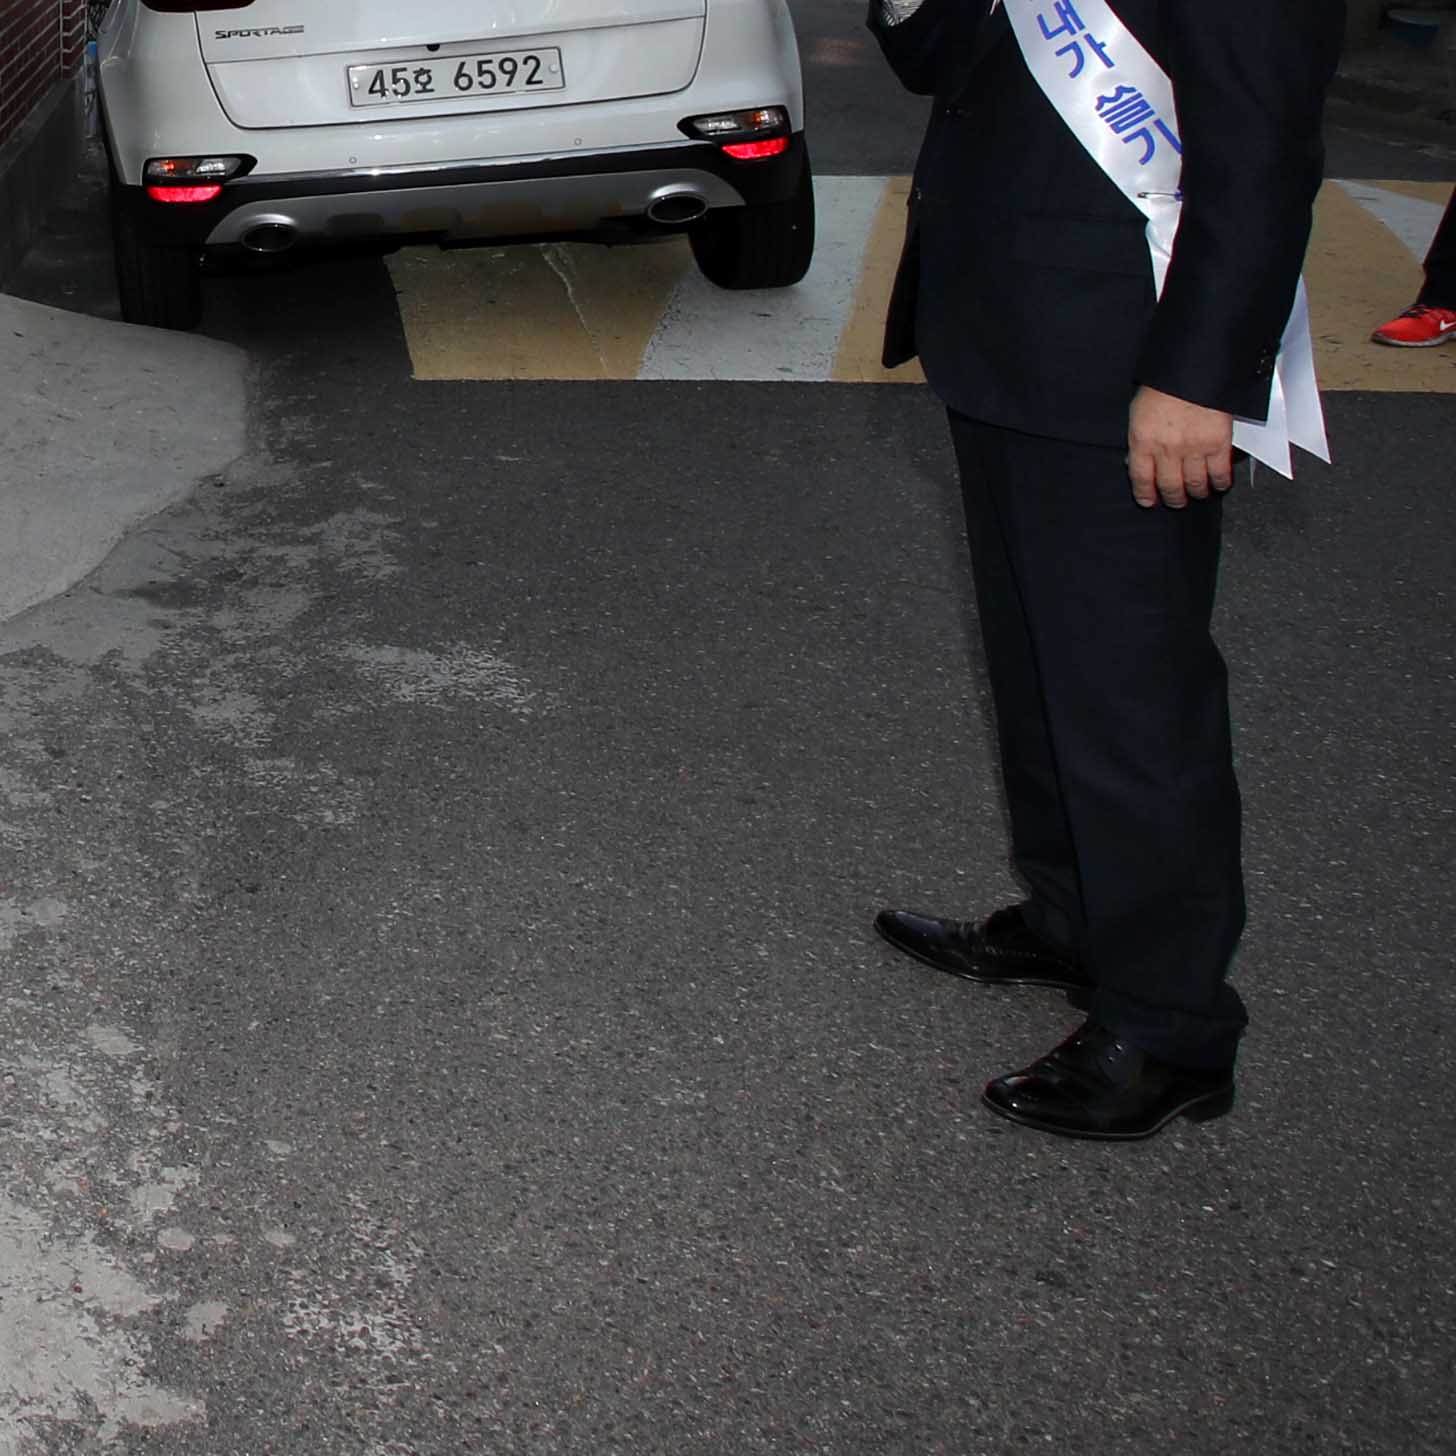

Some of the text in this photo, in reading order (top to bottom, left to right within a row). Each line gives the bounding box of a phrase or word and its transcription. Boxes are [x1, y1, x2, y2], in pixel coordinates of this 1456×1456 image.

[367, 55, 544, 99] 45호 6592
[1096, 84, 1184, 167] 쓸기
